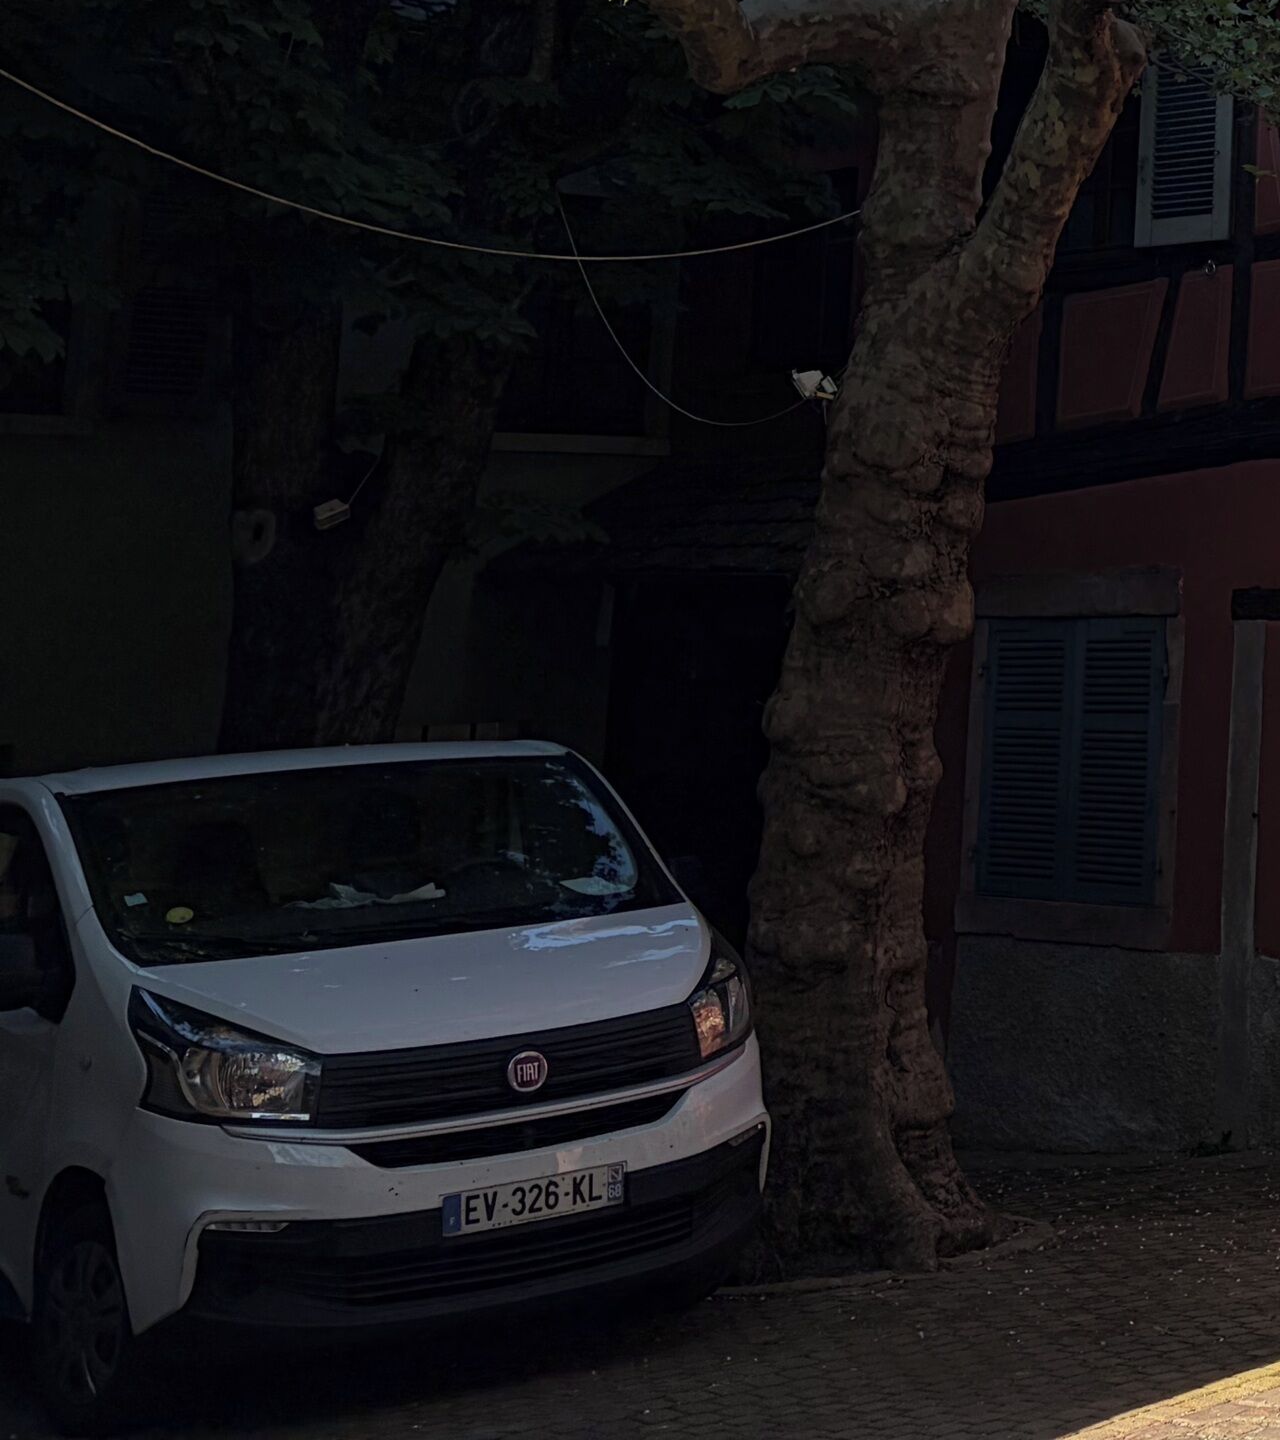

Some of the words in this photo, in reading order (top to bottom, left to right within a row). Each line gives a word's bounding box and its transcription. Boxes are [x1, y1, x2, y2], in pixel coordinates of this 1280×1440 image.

[516, 1062, 539, 1083] FIAT
[464, 1173, 603, 1226] EV-326-KL
[608, 1183, 622, 1198] 68
